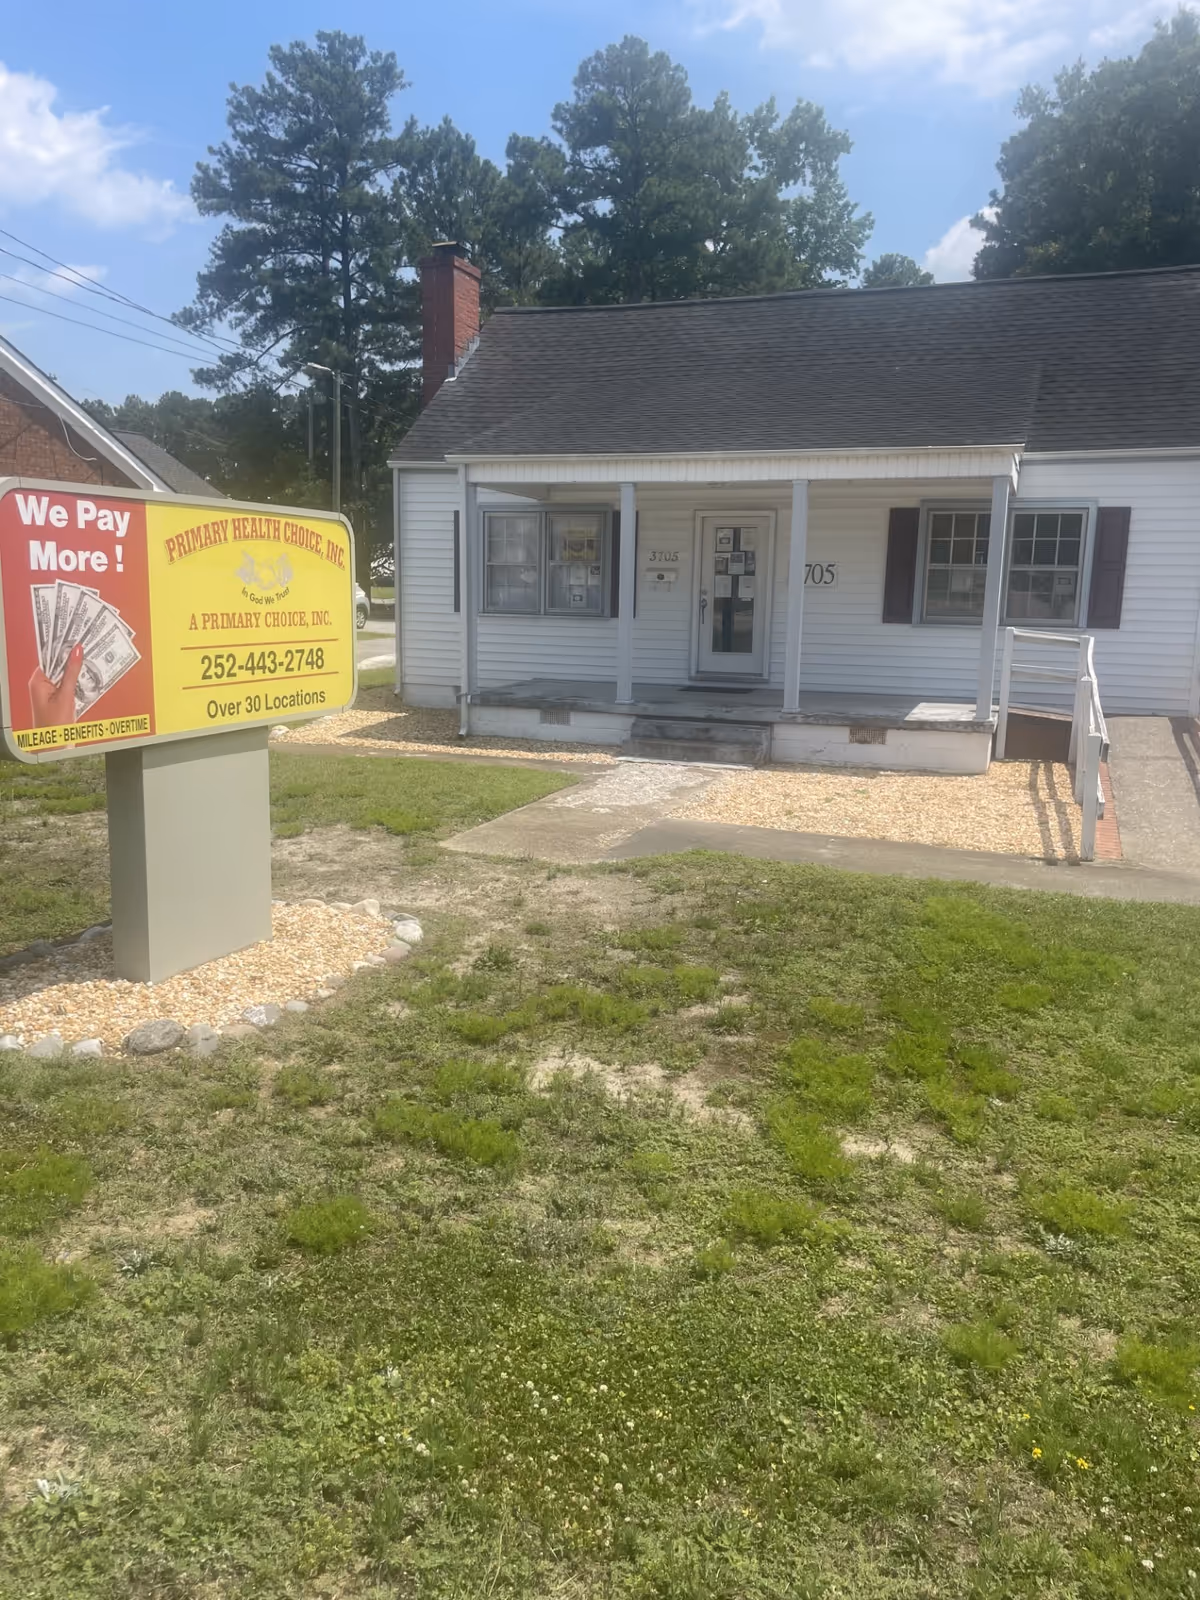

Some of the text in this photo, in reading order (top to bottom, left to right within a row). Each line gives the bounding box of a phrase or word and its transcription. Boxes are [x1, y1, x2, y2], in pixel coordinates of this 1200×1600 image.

[15, 493, 131, 538] We Pay
[28, 539, 109, 573] More
[163, 516, 346, 571] PRIMARY HEALTH CHOICE, INC.
[648, 550, 680, 562] 3705
[803, 563, 836, 585] 705
[241, 586, 291, 605] In God We Trust
[188, 609, 333, 631] A PRIMARY CHOICE, INC.
[200, 647, 325, 681] 252-443-2748
[206, 688, 326, 719] Over 30 Locations
[17, 729, 58, 749] MILEAGE
[63, 723, 104, 742] BENEFITS
[110, 717, 148, 735] OVERTIME
